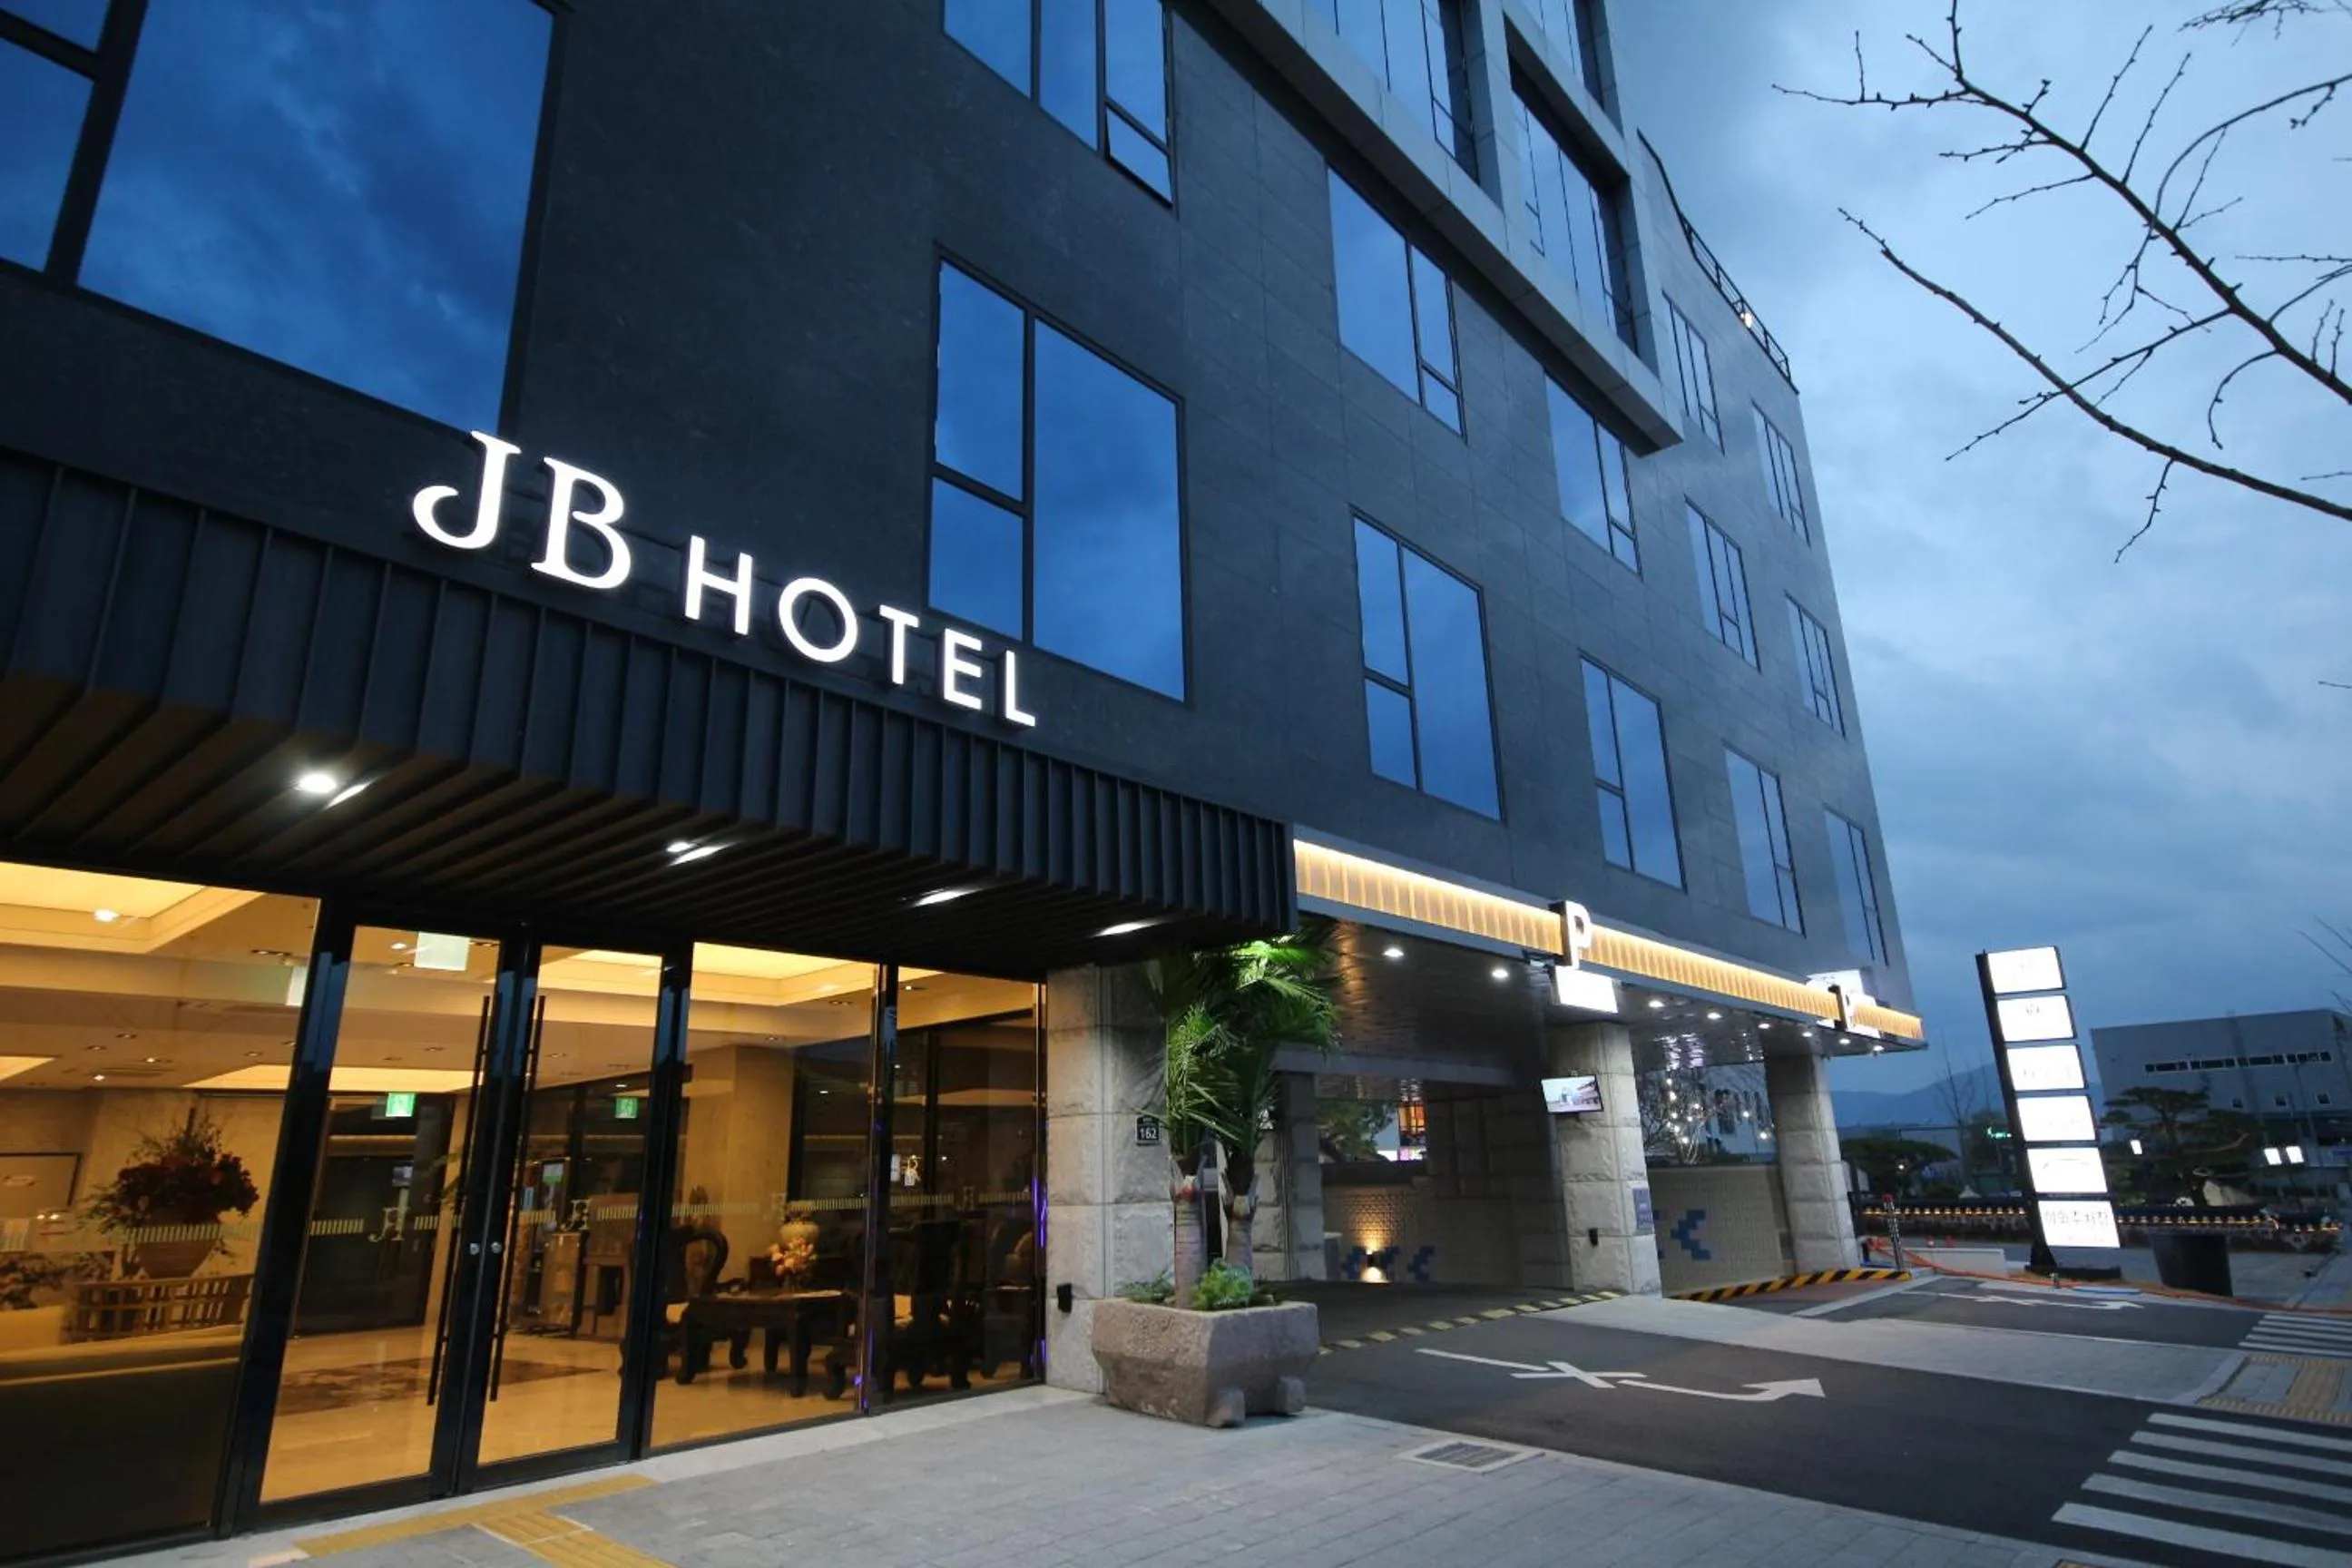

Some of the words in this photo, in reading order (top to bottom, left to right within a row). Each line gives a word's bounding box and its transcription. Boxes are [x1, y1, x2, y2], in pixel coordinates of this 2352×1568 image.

[412, 430, 632, 590] JB
[683, 534, 1036, 727] HOTEL
[1566, 901, 1592, 970] P
[1139, 1127, 1158, 1140] 162
